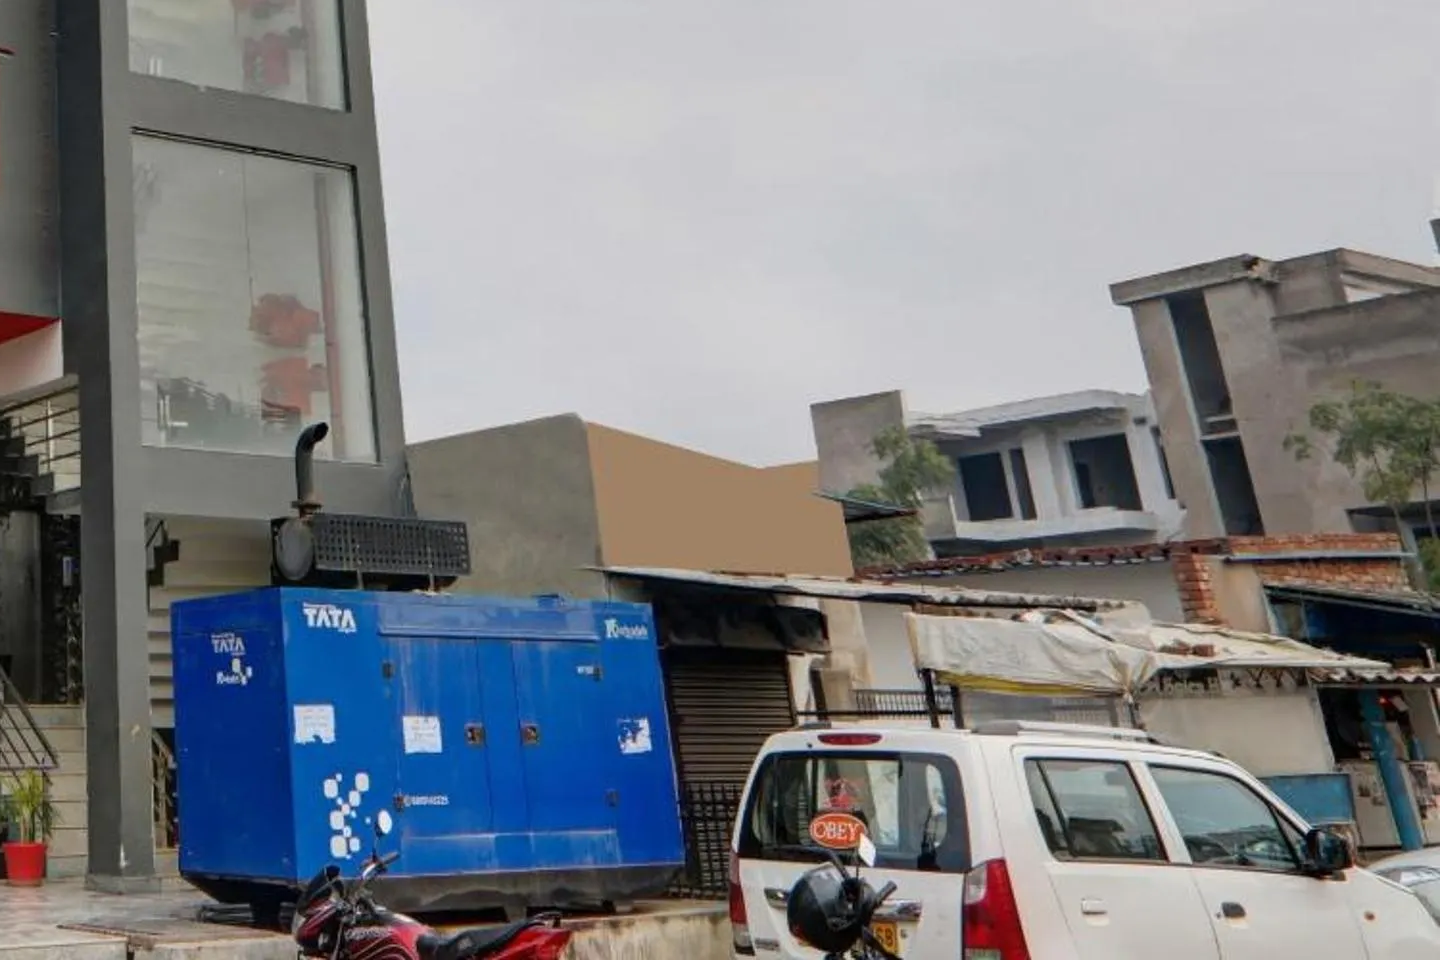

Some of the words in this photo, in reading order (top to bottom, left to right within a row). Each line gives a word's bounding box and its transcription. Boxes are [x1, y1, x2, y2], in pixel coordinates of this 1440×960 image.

[303, 608, 356, 628] TATA
[211, 638, 245, 653] TATA
[813, 821, 860, 841] OBEY
